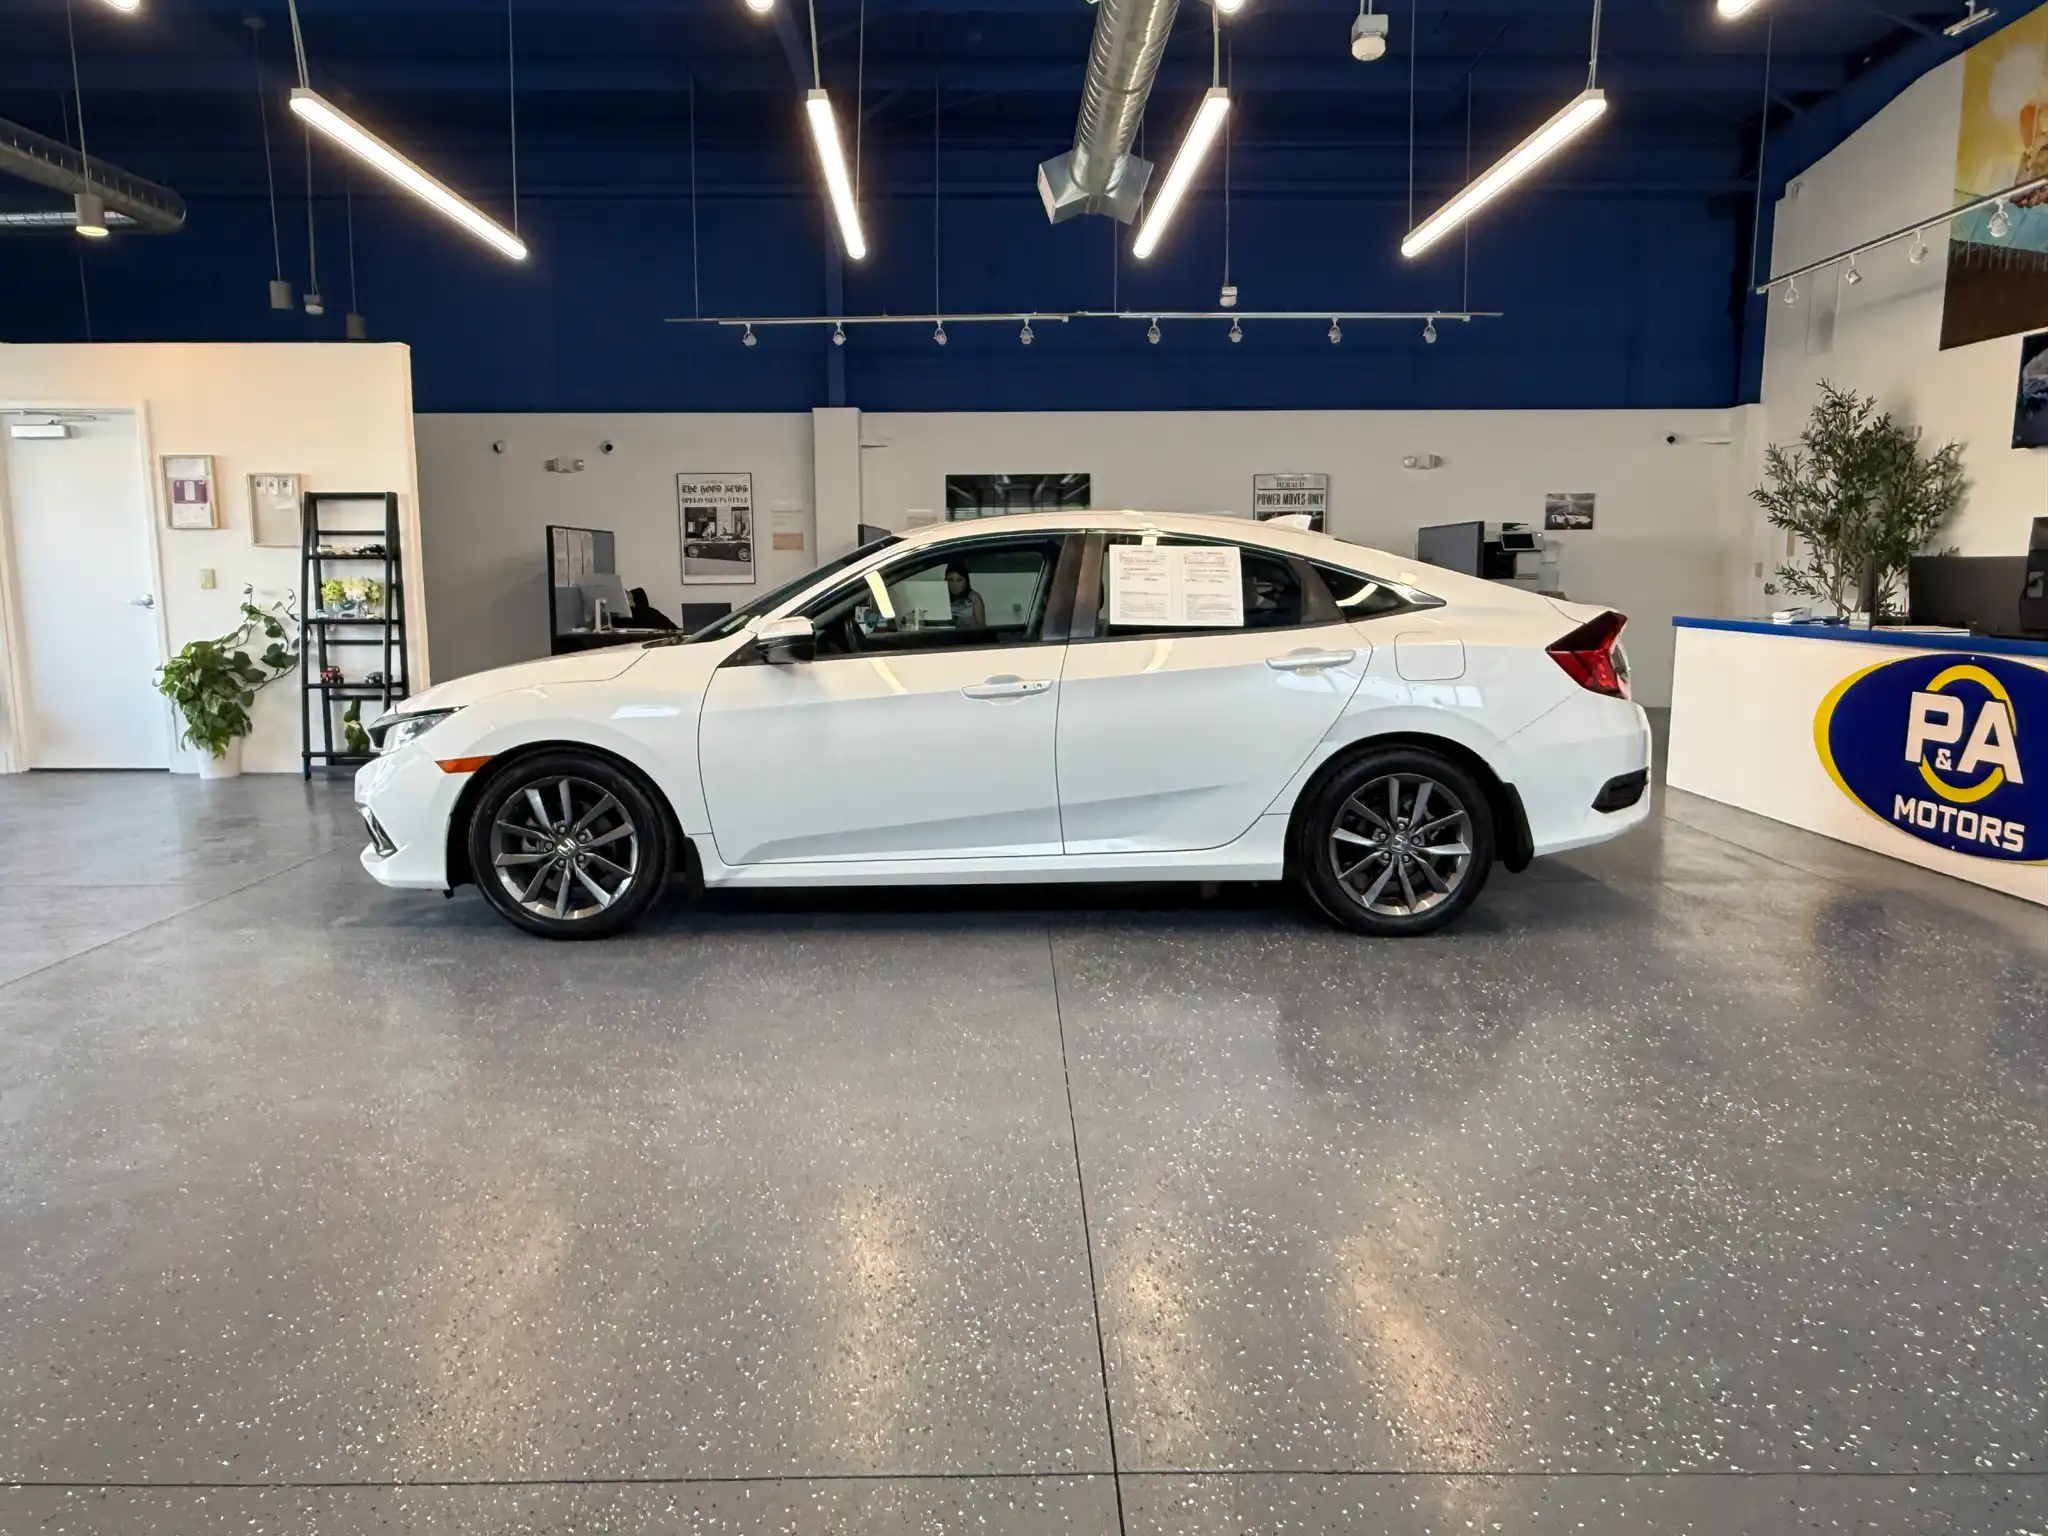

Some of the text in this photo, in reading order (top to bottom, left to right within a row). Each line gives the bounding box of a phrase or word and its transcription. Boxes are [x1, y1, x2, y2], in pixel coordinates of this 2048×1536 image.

[1256, 493, 1325, 505] POWER MOVES ONLY
[1894, 794, 2025, 853] MOTORS
